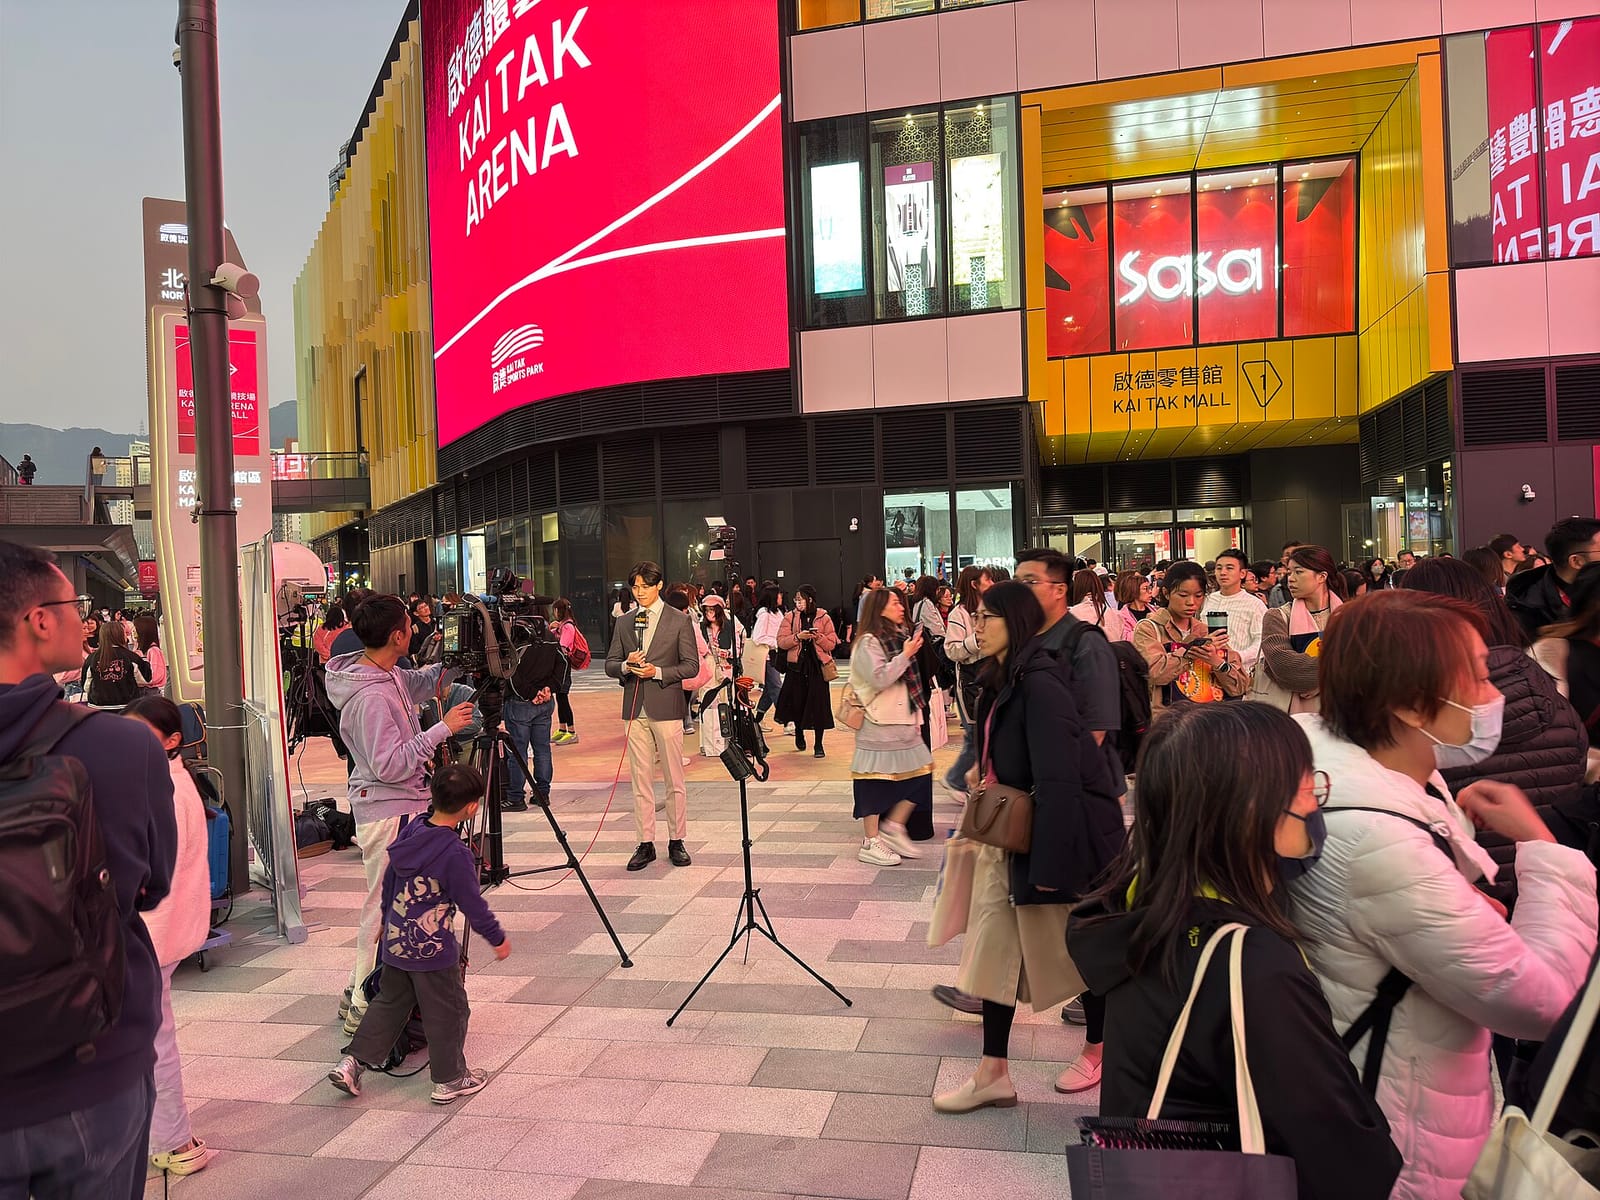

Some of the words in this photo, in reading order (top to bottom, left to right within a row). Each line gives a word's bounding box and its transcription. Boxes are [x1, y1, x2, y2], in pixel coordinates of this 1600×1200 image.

[459, 80, 491, 173] KAI
[495, 6, 592, 115] TAK
[466, 102, 579, 238] ARENA
[506, 361, 514, 374] KAI
[514, 357, 525, 370] TAK
[507, 368, 526, 385] SPORTS
[526, 362, 544, 377] PARK
[1259, 374, 1267, 391] 1
[181, 399, 195, 408] KA
[1113, 398, 1141, 414] KAI
[1145, 395, 1179, 412] TAK
[1183, 391, 1231, 409] MALL
[178, 484, 195, 495] KA
[178, 496, 196, 507] MA
